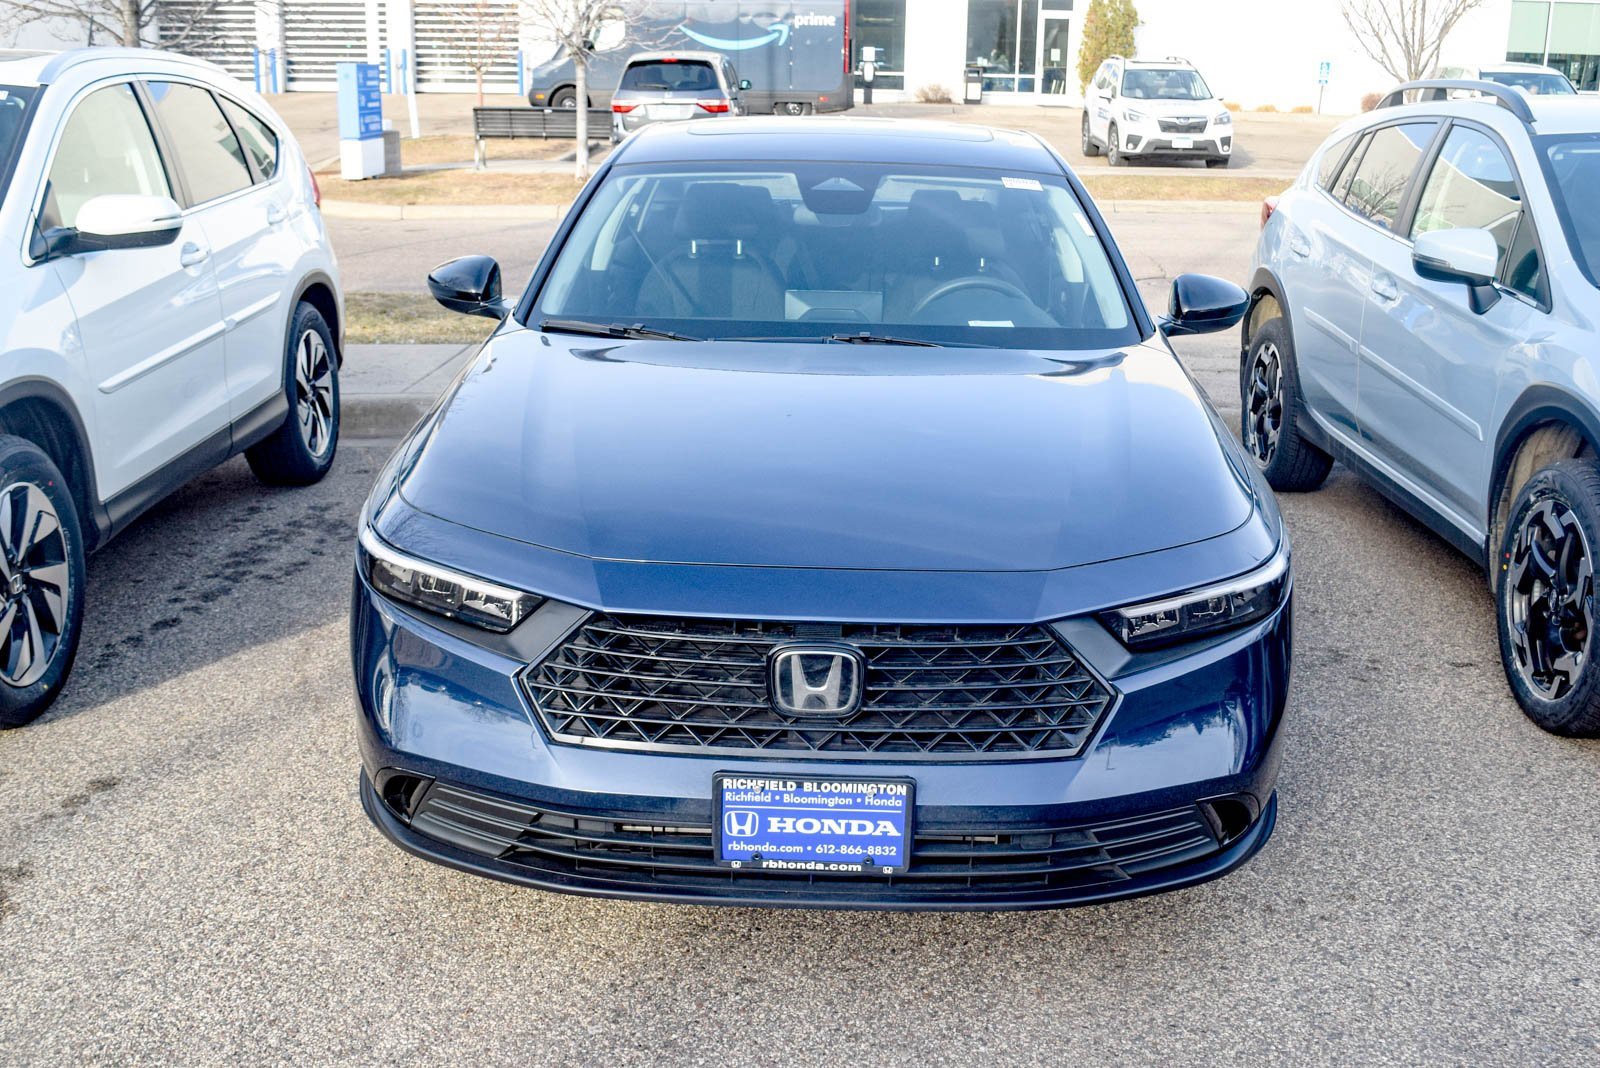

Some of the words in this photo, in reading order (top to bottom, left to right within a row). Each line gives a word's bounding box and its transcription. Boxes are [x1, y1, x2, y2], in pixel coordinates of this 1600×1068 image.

[794, 12, 836, 29] prime
[723, 779, 797, 792] RICHFIELD
[803, 782, 907, 796] BLOOMINGTON
[725, 792, 771, 803] Richfield
[783, 794, 853, 807] Bloomington
[865, 797, 902, 807] Honda
[767, 817, 901, 836] HONDA
[728, 841, 803, 853] rbhonda.com
[815, 844, 897, 856] 612-866-8832
[762, 860, 862, 872] rbhonda.com
